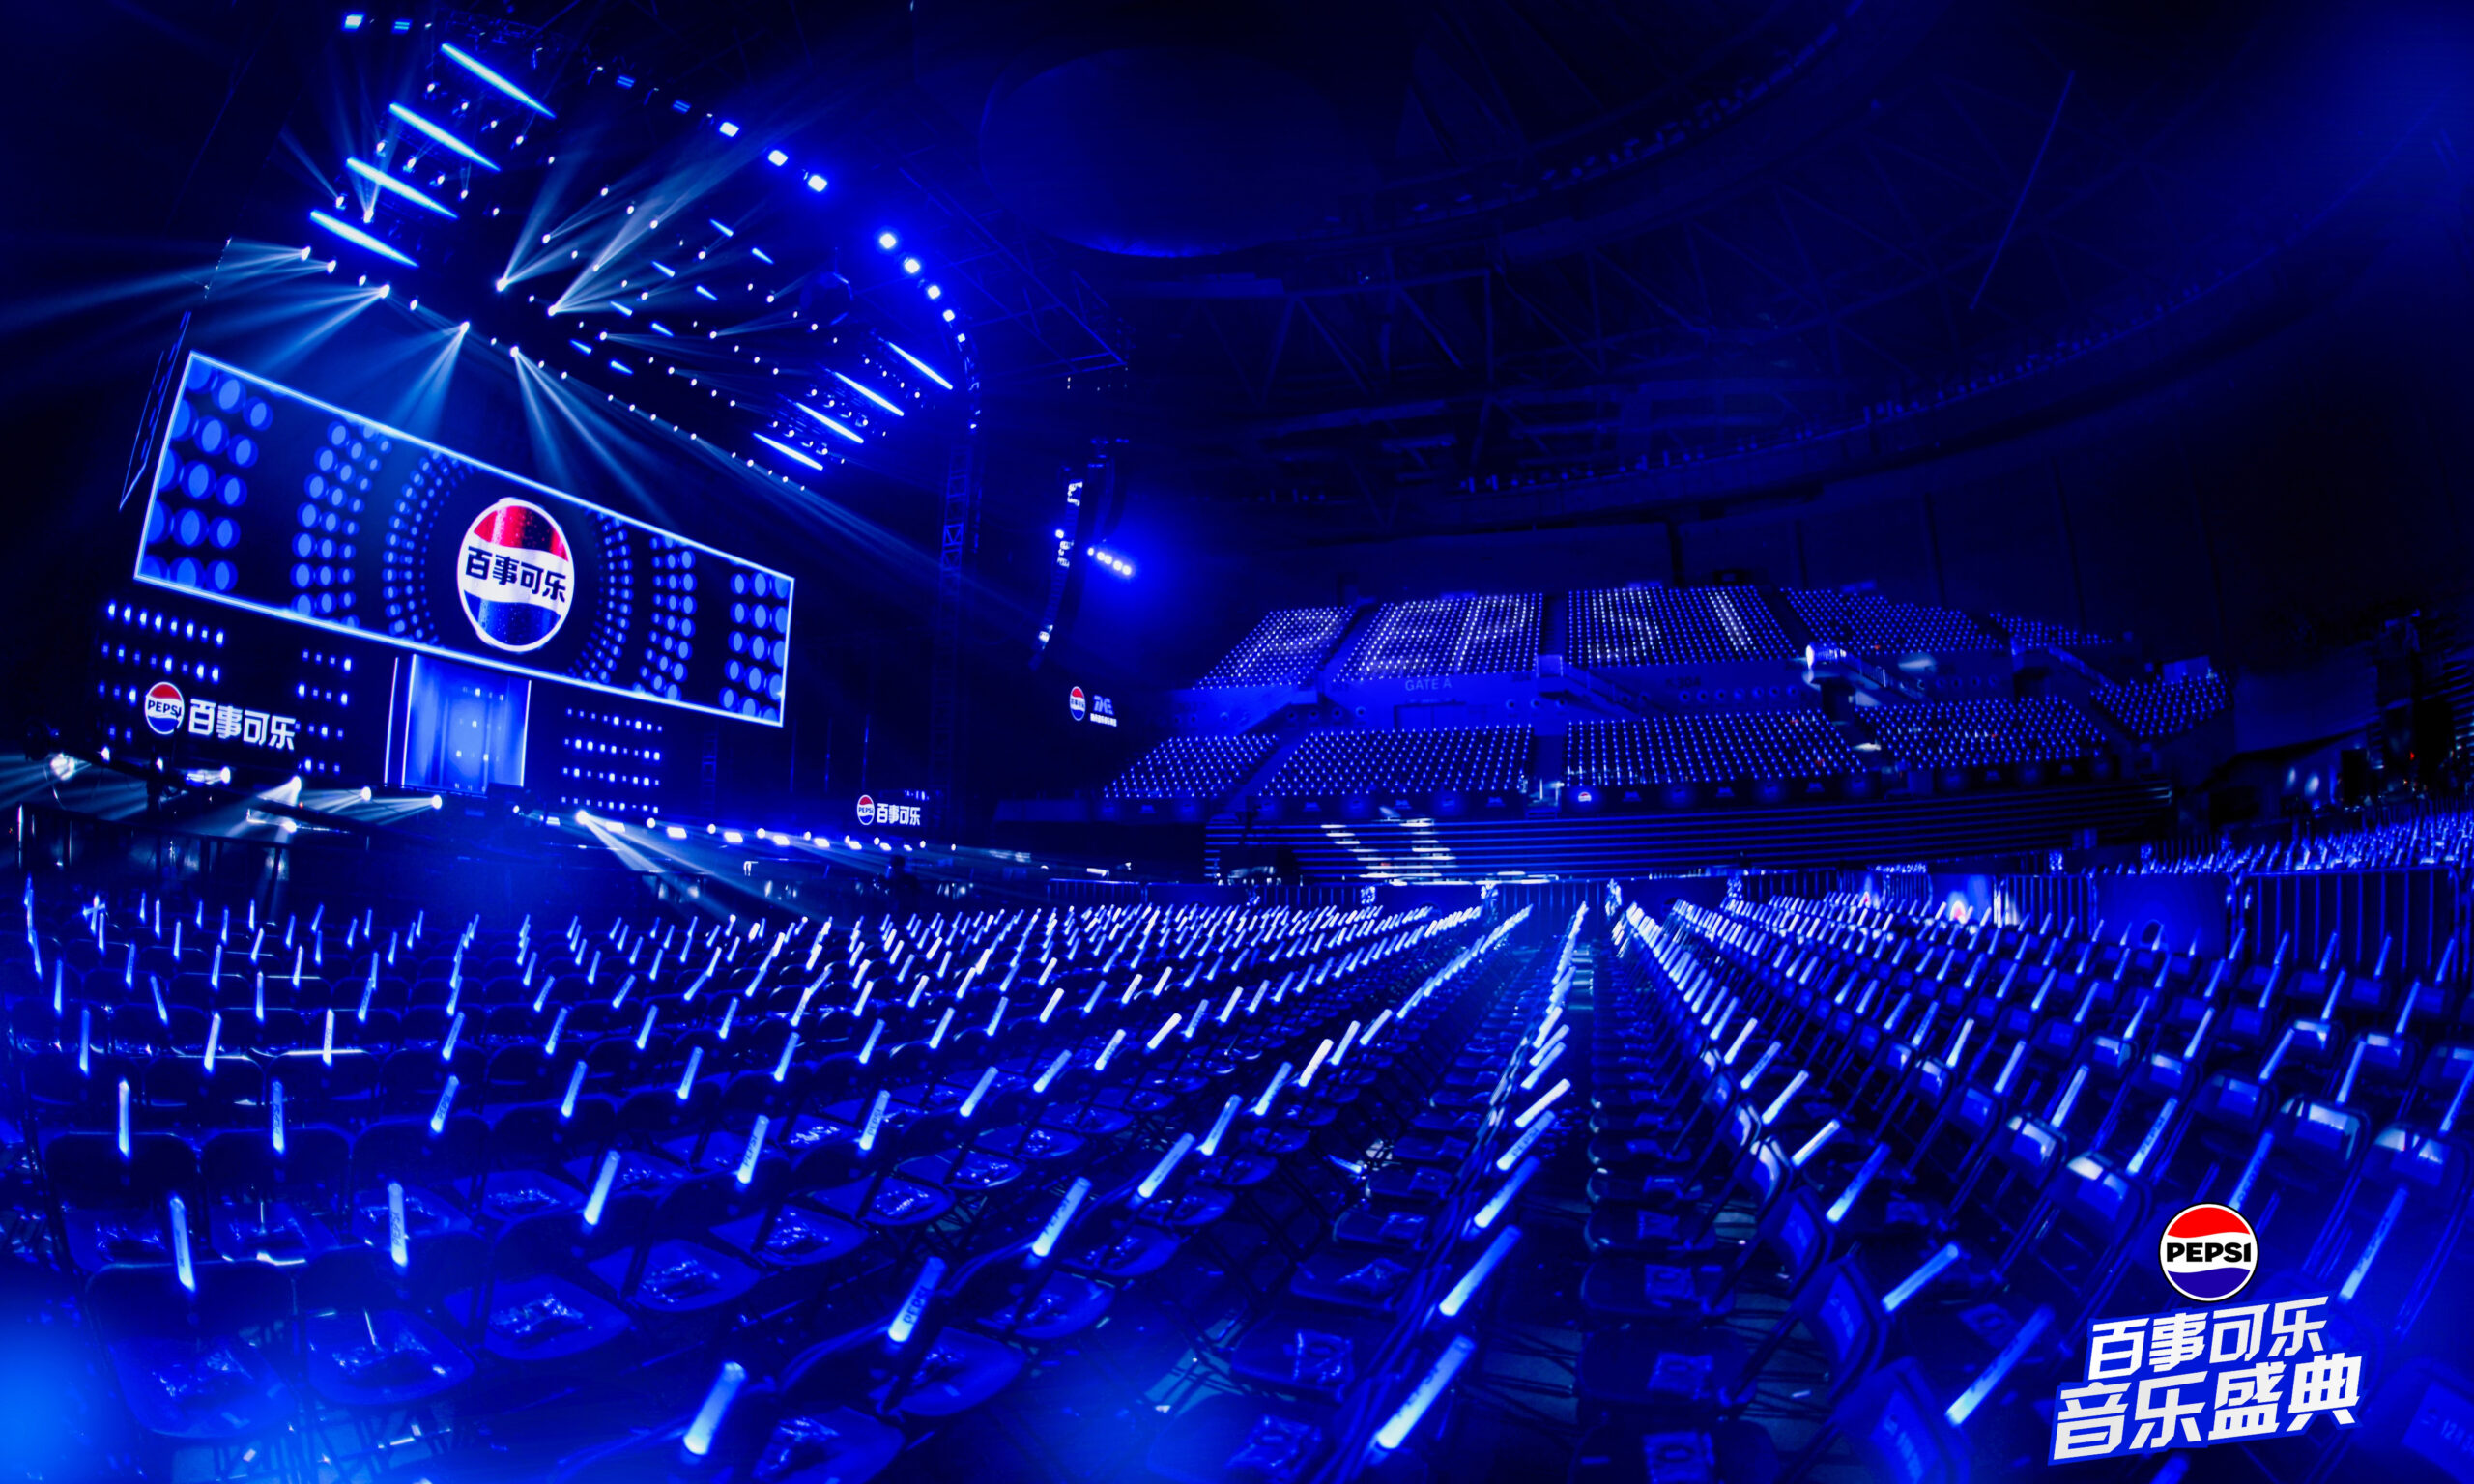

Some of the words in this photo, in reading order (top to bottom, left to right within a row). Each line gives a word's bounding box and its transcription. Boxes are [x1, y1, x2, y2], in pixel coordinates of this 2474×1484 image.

[466, 546, 566, 603] 百事可乐
[1404, 678, 1439, 692] GATE
[1442, 677, 1453, 689] A
[148, 699, 181, 716] PEPSI
[187, 698, 297, 751] 百事可乐
[877, 803, 921, 826] 百事可乐
[902, 1284, 935, 1326] PEPSI
